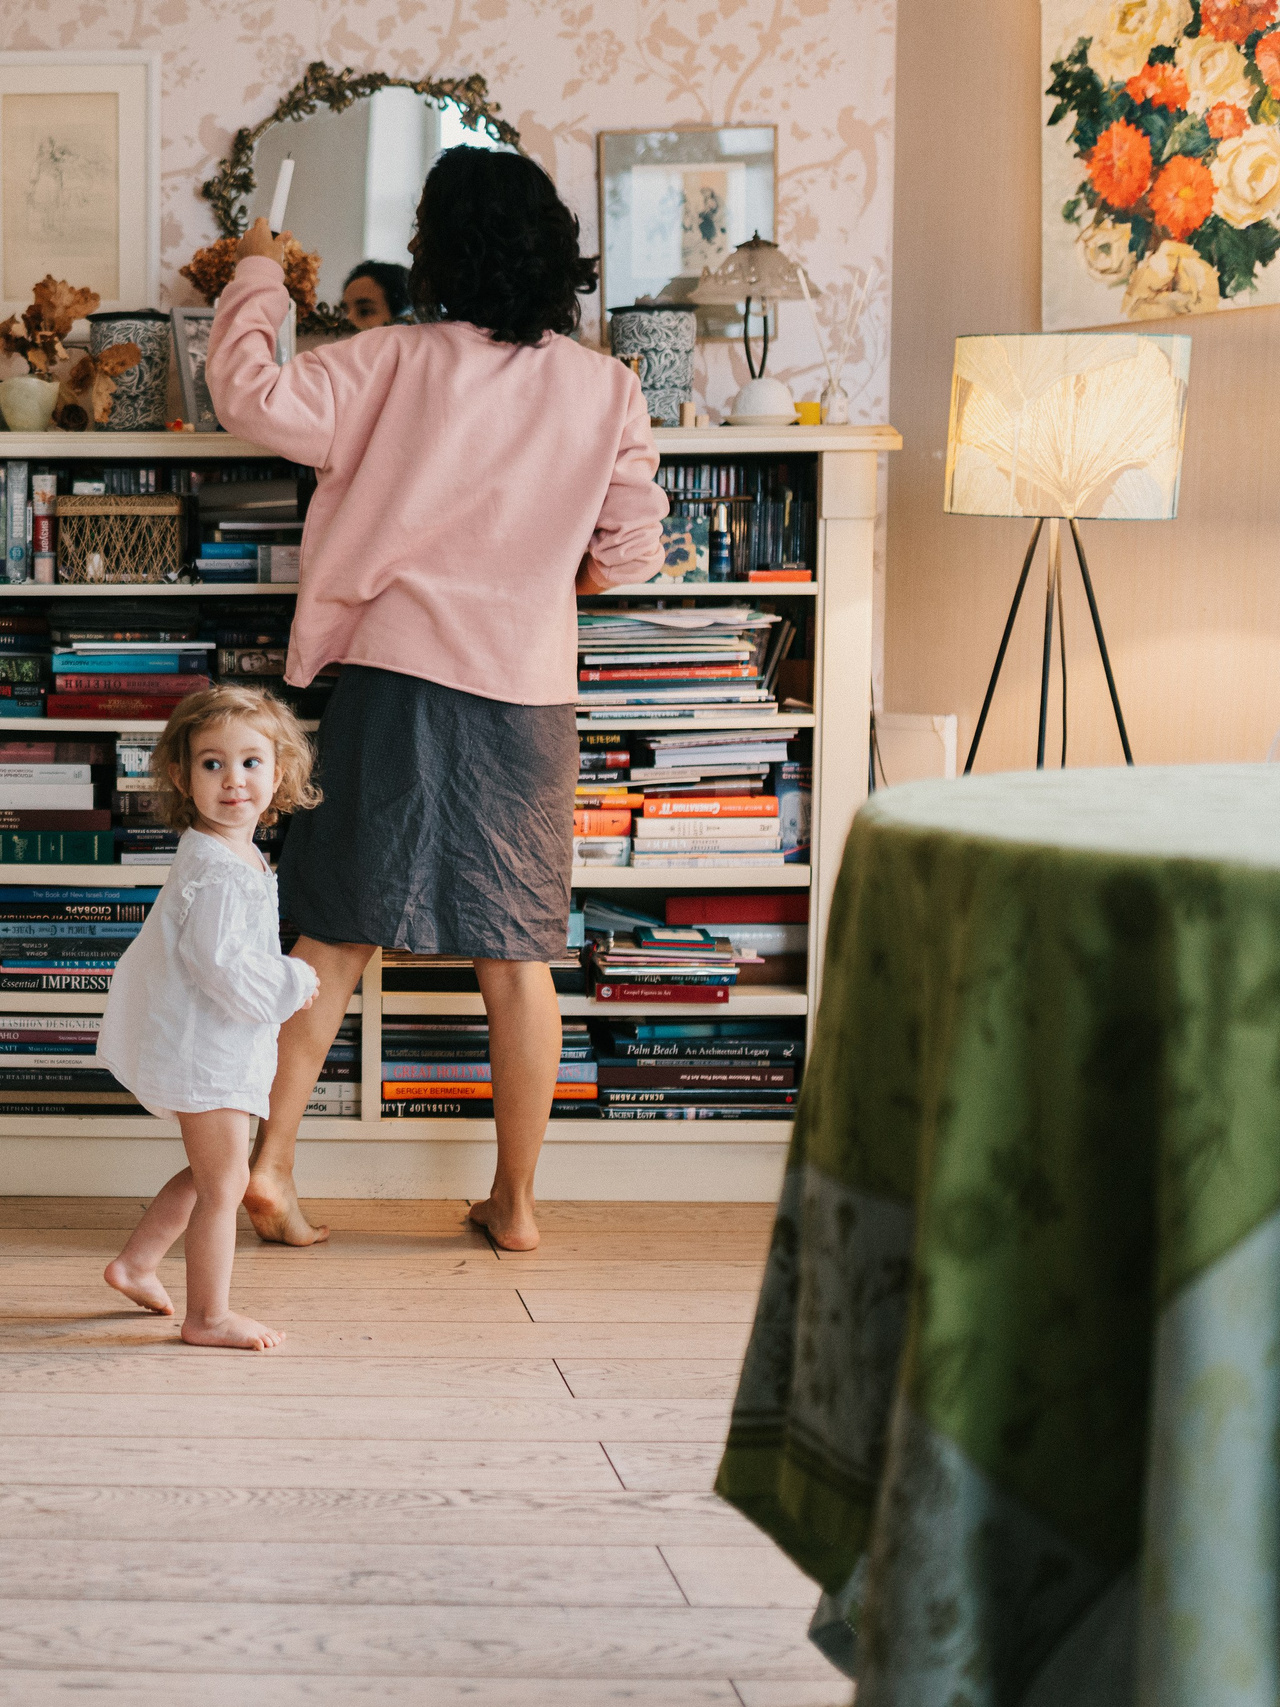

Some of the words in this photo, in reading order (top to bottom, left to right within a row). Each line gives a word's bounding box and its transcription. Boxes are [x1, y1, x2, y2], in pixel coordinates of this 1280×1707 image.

[65, 680, 122, 690] ОНЕГИН
[33, 891, 43, 899] The
[45, 891, 61, 899] Book
[62, 891, 68, 899] of
[70, 891, 84, 899] New
[86, 891, 102, 899] Israeli
[104, 891, 120, 899] Food
[65, 905, 111, 915] СЛОВАРЬ
[1, 978, 40, 988] Essential
[1, 1019, 43, 1028] FASHION
[46, 1019, 101, 1029] DESIGNERS
[627, 1045, 651, 1055] Palm
[653, 1045, 679, 1055] Beach
[685, 1047, 697, 1055] An
[699, 1047, 744, 1056] Architectural
[745, 1048, 770, 1058] Legacy
[393, 1065, 432, 1079] GREAT
[395, 1087, 428, 1095] SERGEY
[429, 1087, 476, 1095] BERMENIEV
[609, 1093, 637, 1101] РАБИН
[639, 1093, 664, 1101] ОСКАР
[410, 1103, 461, 1113] САЛЬВАДОР
[608, 1109, 634, 1119] ANCIENT
[636, 1109, 657, 1119] EGYPT
